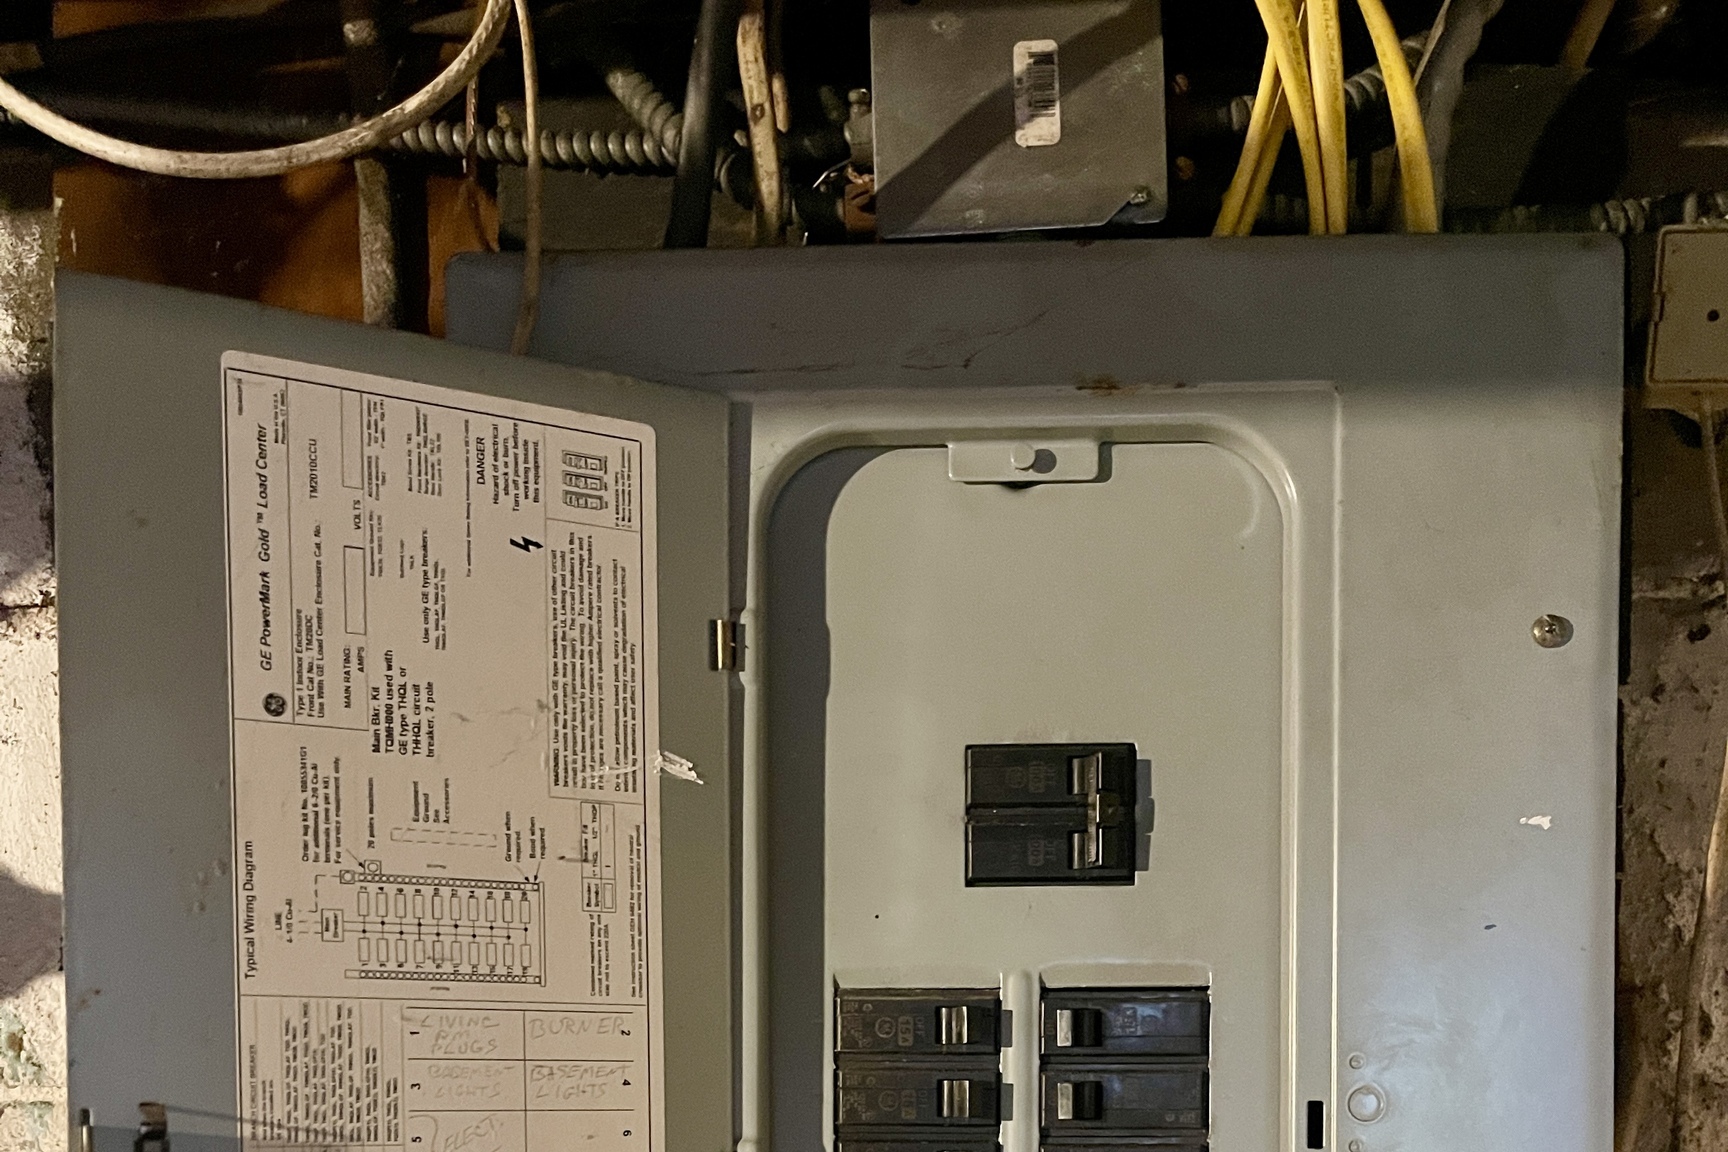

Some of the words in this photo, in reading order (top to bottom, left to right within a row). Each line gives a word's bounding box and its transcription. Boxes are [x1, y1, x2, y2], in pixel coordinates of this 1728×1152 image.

[256, 424, 267, 469] Center
[309, 439, 318, 499] TM2010CCU
[476, 437, 485, 485] DANGER
[256, 473, 268, 508] Load
[353, 500, 361, 530] VOLTS
[258, 528, 270, 562] Gold
[422, 569, 430, 588] type
[422, 591, 429, 604] GE
[259, 571, 271, 646] PowerMark
[422, 606, 431, 625] only
[260, 650, 272, 671] GE
[316, 639, 324, 661] Load
[384, 650, 393, 671] with
[316, 664, 324, 677] GE
[399, 667, 406, 677] or
[306, 677, 314, 692] Cat
[371, 687, 380, 700] Kit
[384, 675, 393, 700] used
[425, 682, 435, 703] pole
[296, 695, 305, 716] Type
[316, 702, 324, 718] Use
[412, 684, 420, 715] circuit
[371, 705, 380, 725] Bkr.
[399, 714, 409, 736] type
[372, 729, 380, 753] Main
[398, 740, 408, 755] GE
[243, 841, 256, 891] Diagram
[244, 895, 256, 934] Wiring
[244, 937, 257, 979] Typical
[528, 1018, 624, 1038] BURNER
[432, 1040, 498, 1055] PLUGS
[530, 1064, 630, 1081] BASEMENT
[536, 1083, 605, 1099] LIGHTS
